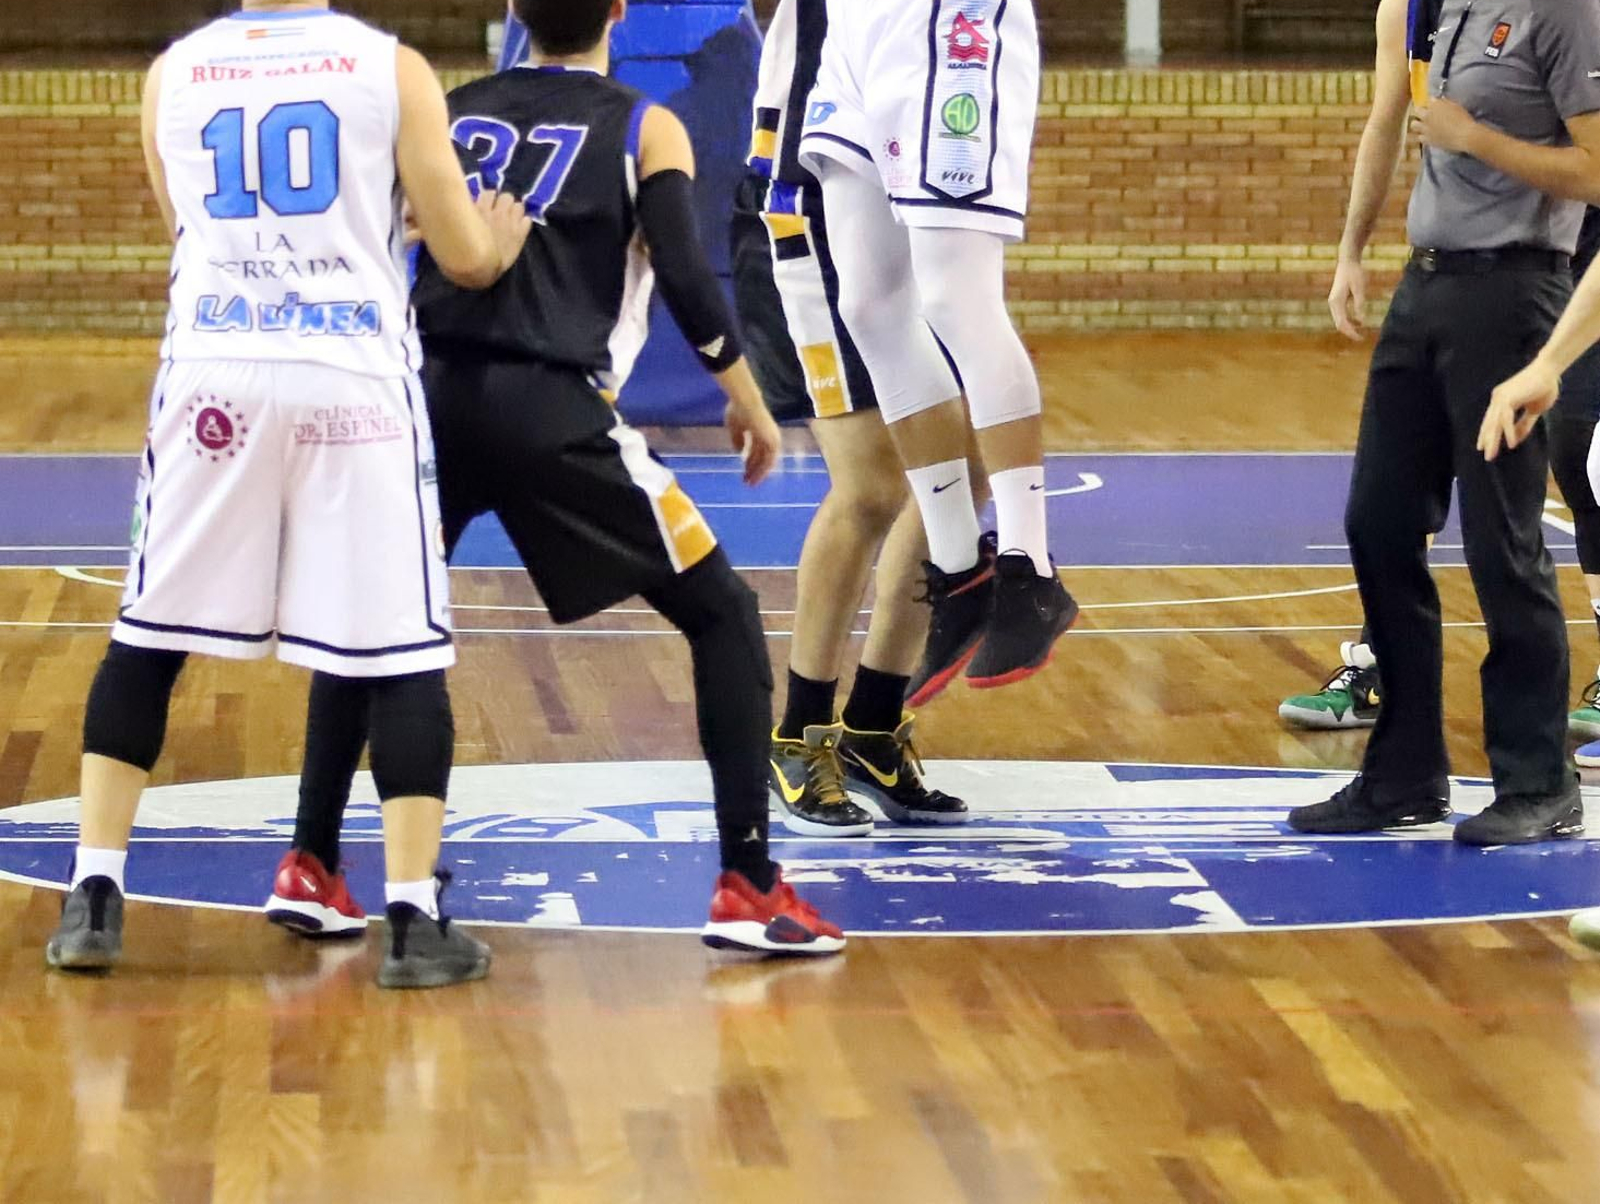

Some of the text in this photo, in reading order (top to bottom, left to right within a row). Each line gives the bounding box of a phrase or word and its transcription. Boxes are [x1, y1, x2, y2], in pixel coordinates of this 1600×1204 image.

[191, 57, 357, 84] RUIZ GALAN
[201, 100, 340, 219] 10
[450, 115, 589, 226] 37
[192, 294, 253, 333] LA
